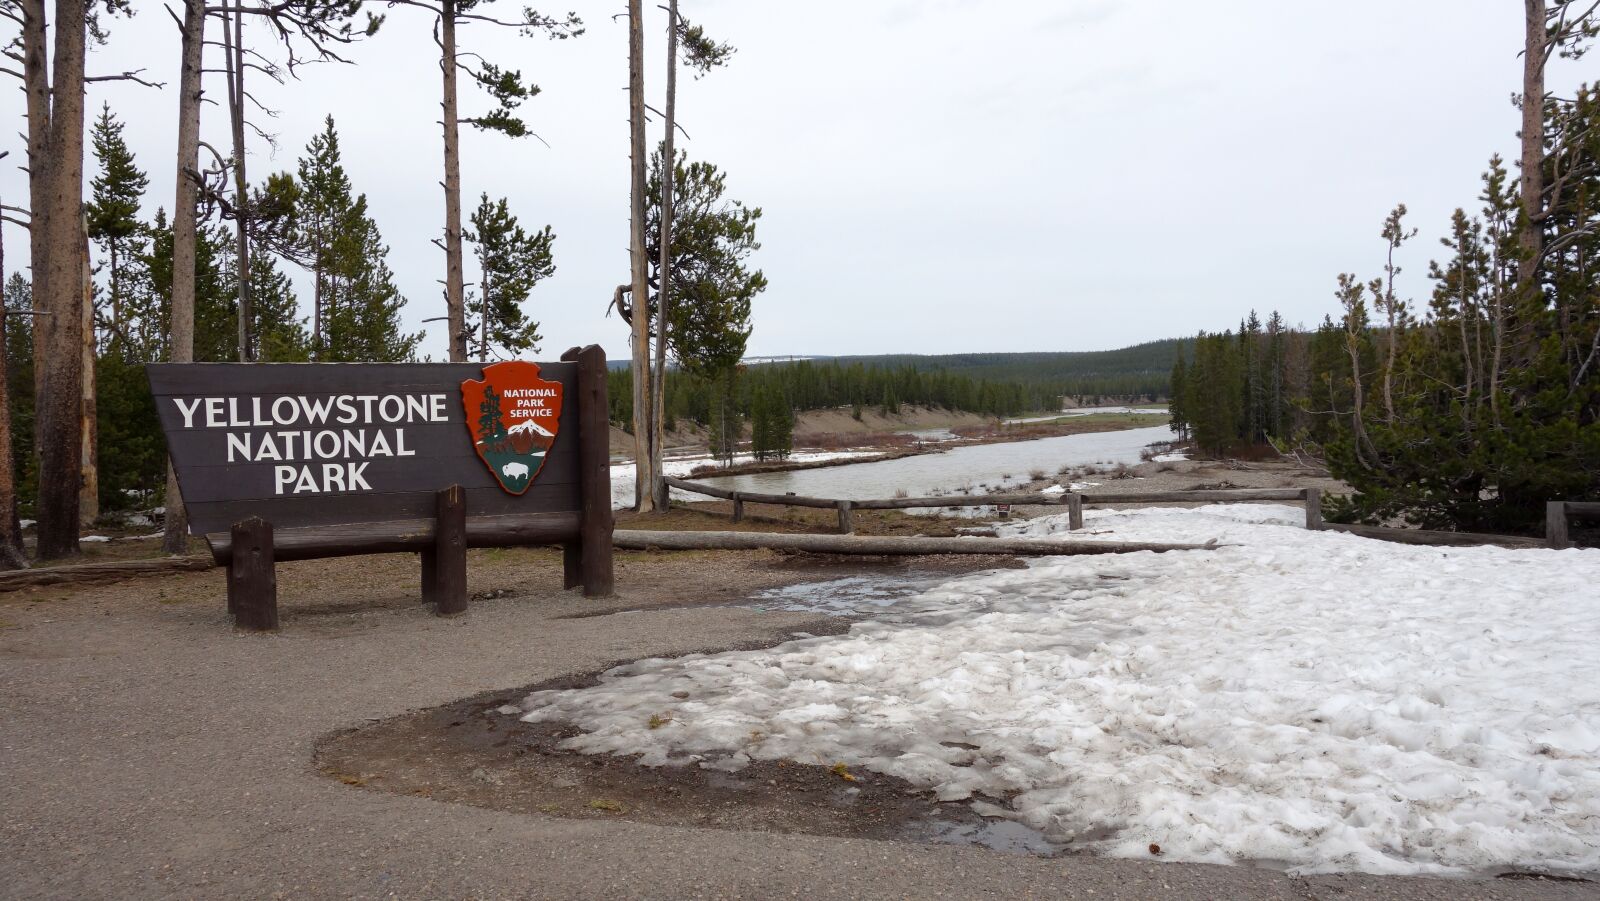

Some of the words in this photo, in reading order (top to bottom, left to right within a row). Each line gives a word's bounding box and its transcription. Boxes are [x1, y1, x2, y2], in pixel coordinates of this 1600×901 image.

[503, 389, 557, 398] NATIONAL
[517, 399, 544, 407] PARK
[173, 394, 449, 428] YELLOWSTONE
[510, 409, 552, 417] SERVICE
[227, 428, 415, 462] NATIONAL
[274, 461, 373, 494] PARK
